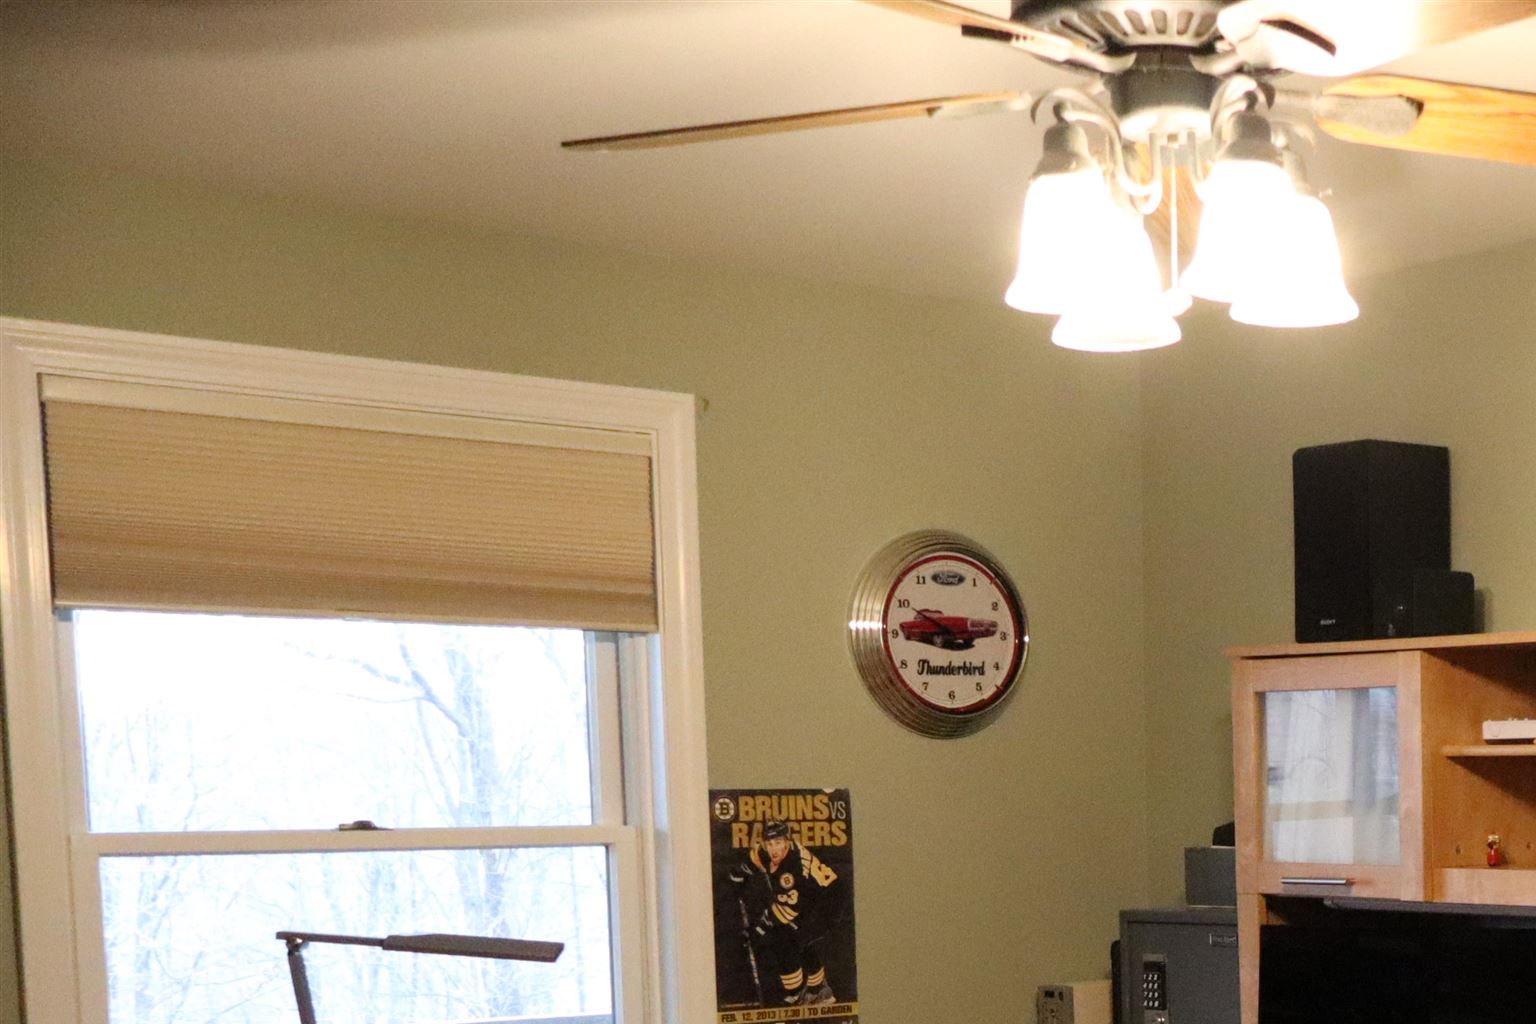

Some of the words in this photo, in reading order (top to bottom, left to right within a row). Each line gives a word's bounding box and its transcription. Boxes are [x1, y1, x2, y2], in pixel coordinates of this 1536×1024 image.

[917, 659, 985, 676] Thunderbird
[739, 795, 829, 821] BRUINS
[830, 801, 847, 819] VS
[732, 820, 848, 848] RAGERS
